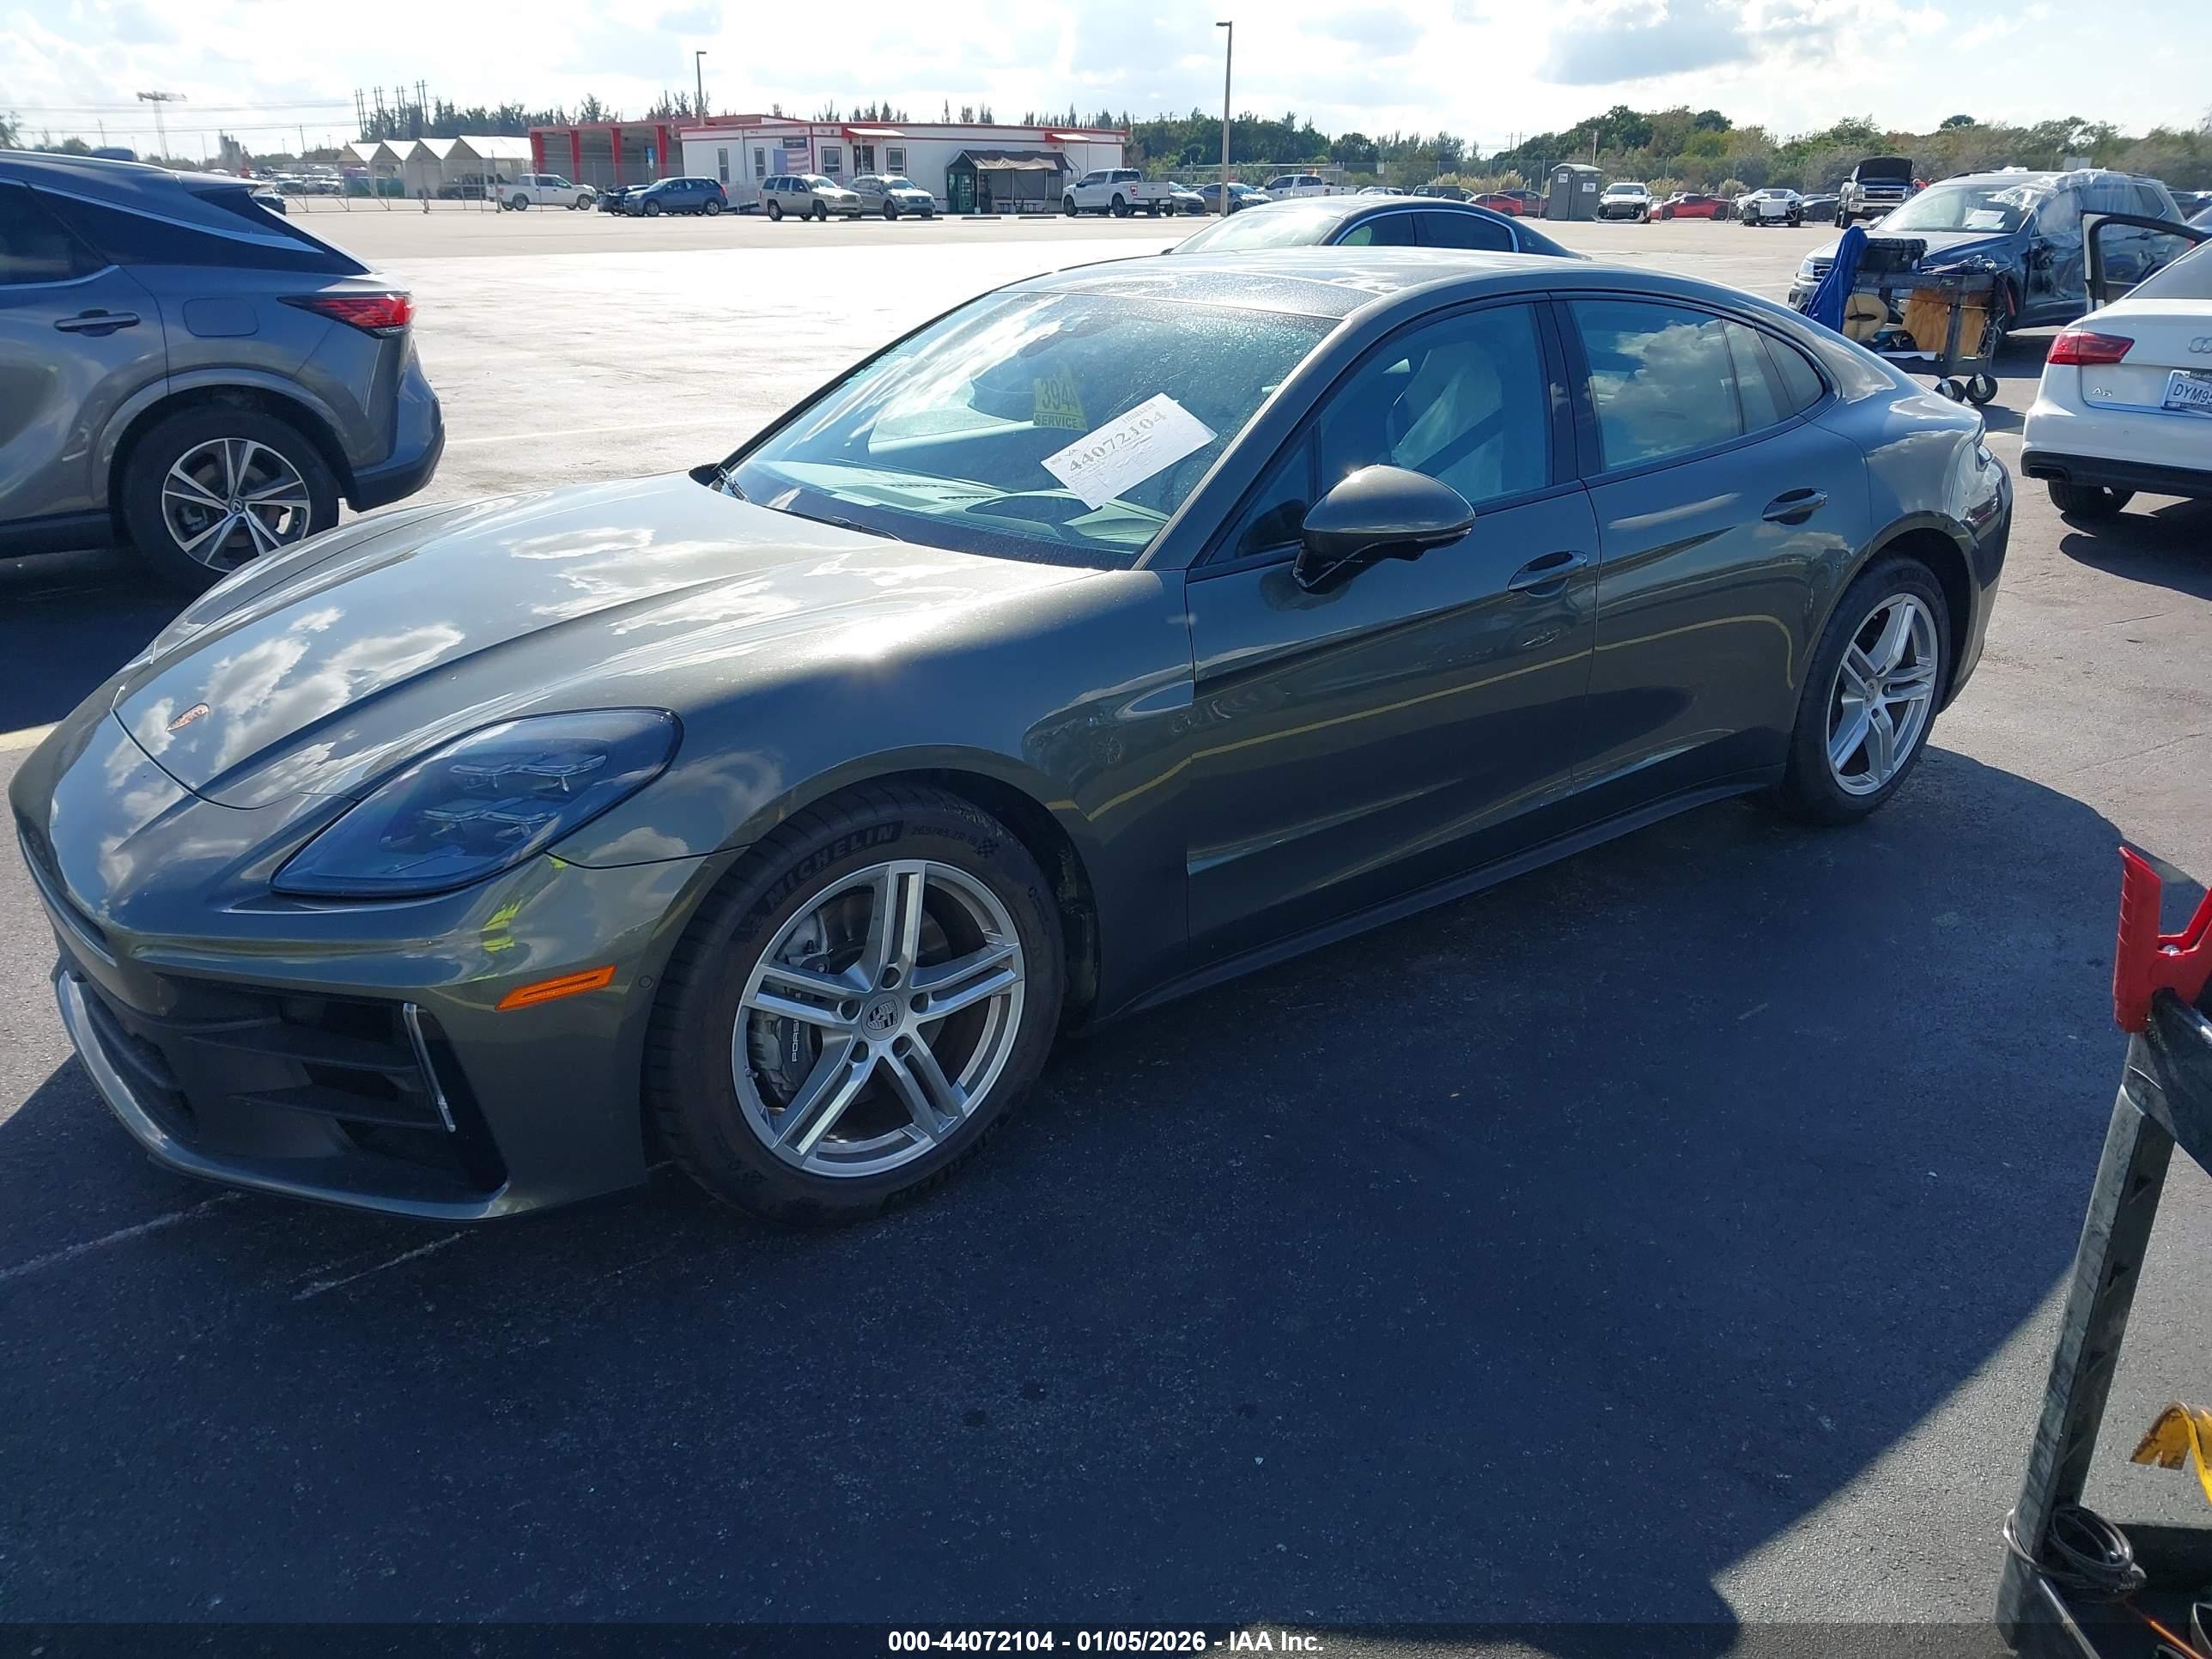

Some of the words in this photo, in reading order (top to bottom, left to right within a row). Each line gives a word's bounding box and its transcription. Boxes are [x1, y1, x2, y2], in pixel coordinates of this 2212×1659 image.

[1033, 414, 1079, 428] SERVICE
[1069, 411, 1167, 471] 44072104
[766, 822, 895, 907] MICHELIN
